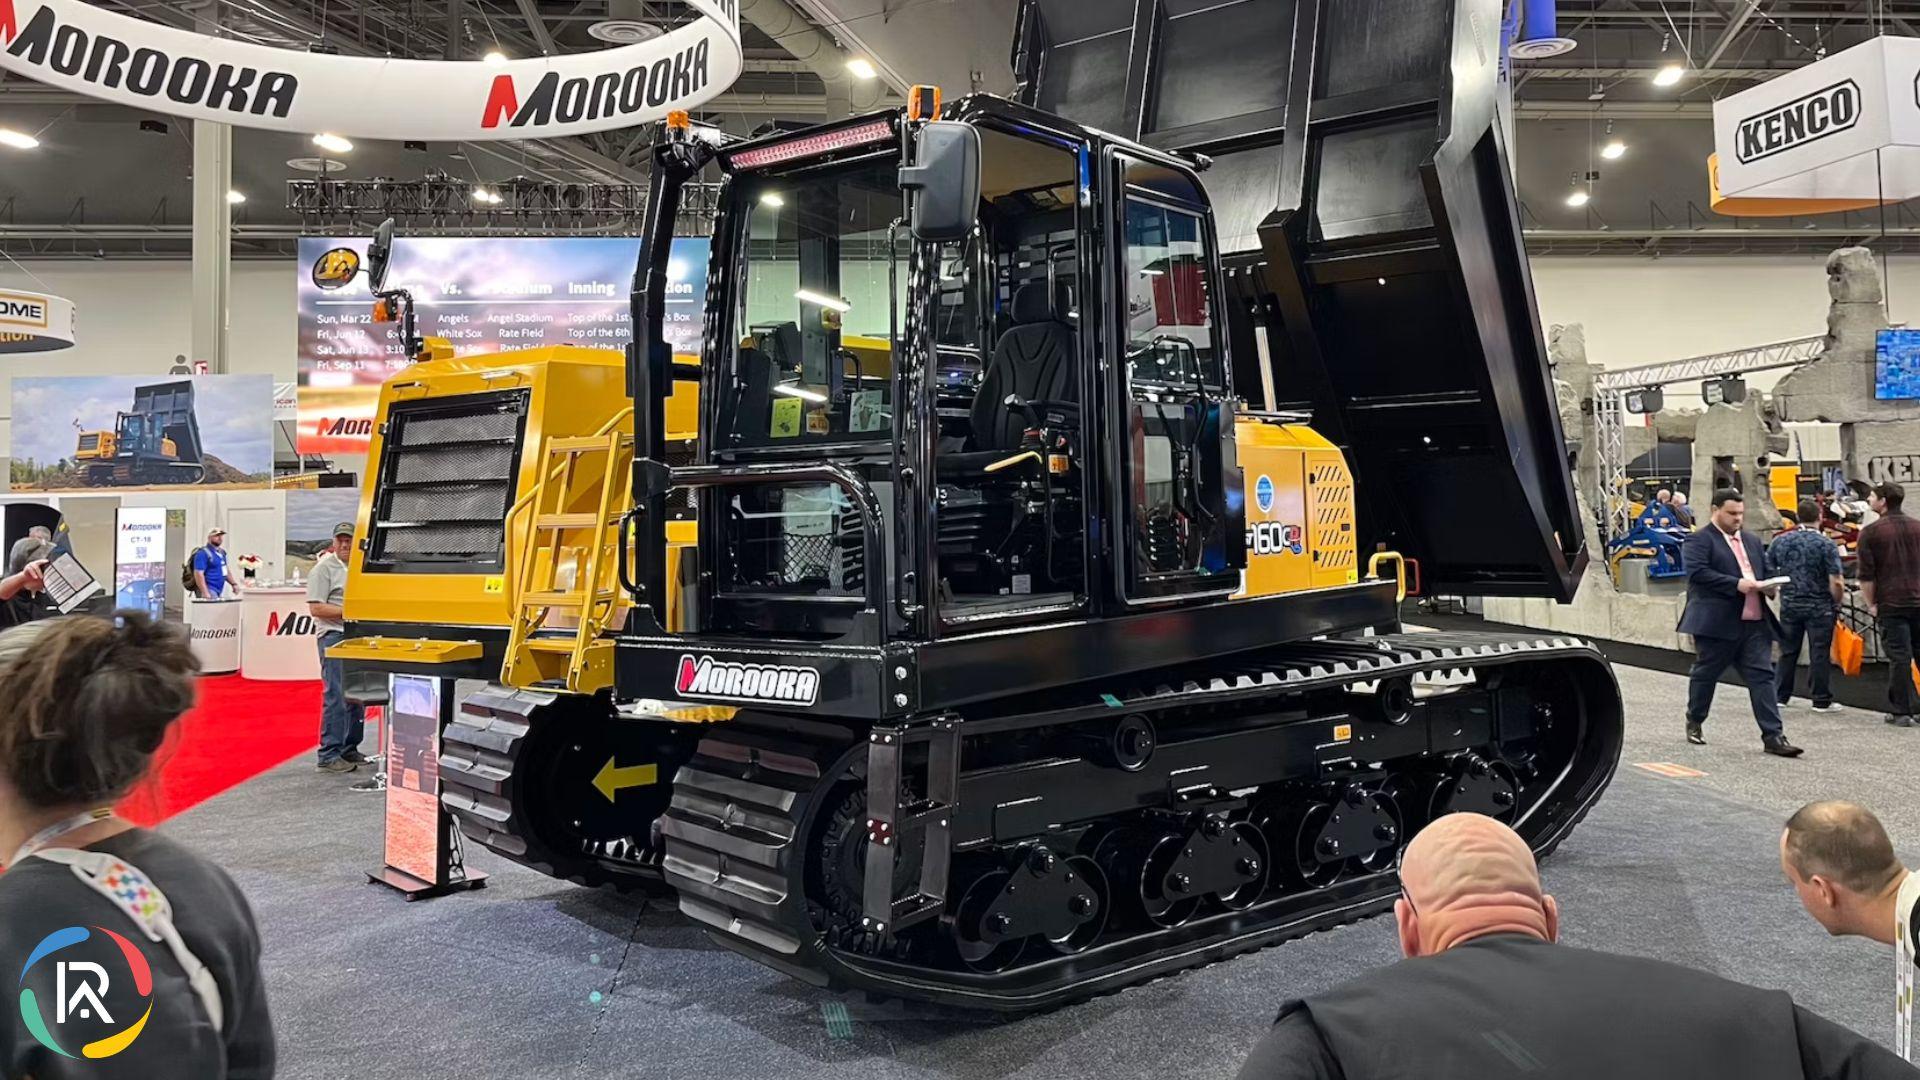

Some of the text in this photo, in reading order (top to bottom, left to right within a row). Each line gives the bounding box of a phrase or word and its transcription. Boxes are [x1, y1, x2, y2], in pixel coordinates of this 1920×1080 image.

[0, 0, 298, 118] MOROOKA
[481, 37, 710, 128] MOROOKA
[1742, 87, 1853, 159] KENCO
[568, 281, 616, 296] Inning
[317, 314, 338, 325] Sun,
[340, 314, 359, 324] Mar
[360, 314, 372, 324] 22
[438, 313, 469, 325] Angels
[488, 313, 514, 325] Angel
[515, 313, 553, 323] Stadium
[568, 313, 585, 325] Top
[587, 312, 598, 322] of
[599, 312, 613, 322] the
[615, 313, 629, 323] 1st
[674, 313, 691, 322] Box
[317, 329, 332, 341] Fri,
[335, 330, 354, 339] Jun
[436, 328, 464, 338] White
[465, 329, 482, 338] Sox
[499, 329, 519, 338] Rate
[521, 328, 544, 338] Field
[568, 328, 585, 340] Top
[587, 328, 597, 338] of
[598, 328, 613, 338] the
[615, 328, 630, 338] 6th
[675, 328, 692, 337] Box
[317, 345, 337, 356] Sat,
[338, 345, 356, 354] Jun
[385, 345, 405, 355] 3:10
[675, 343, 692, 352] Box
[317, 360, 332, 372] Fri,
[334, 360, 352, 373] Sep
[677, 655, 818, 703] MOROOKA
